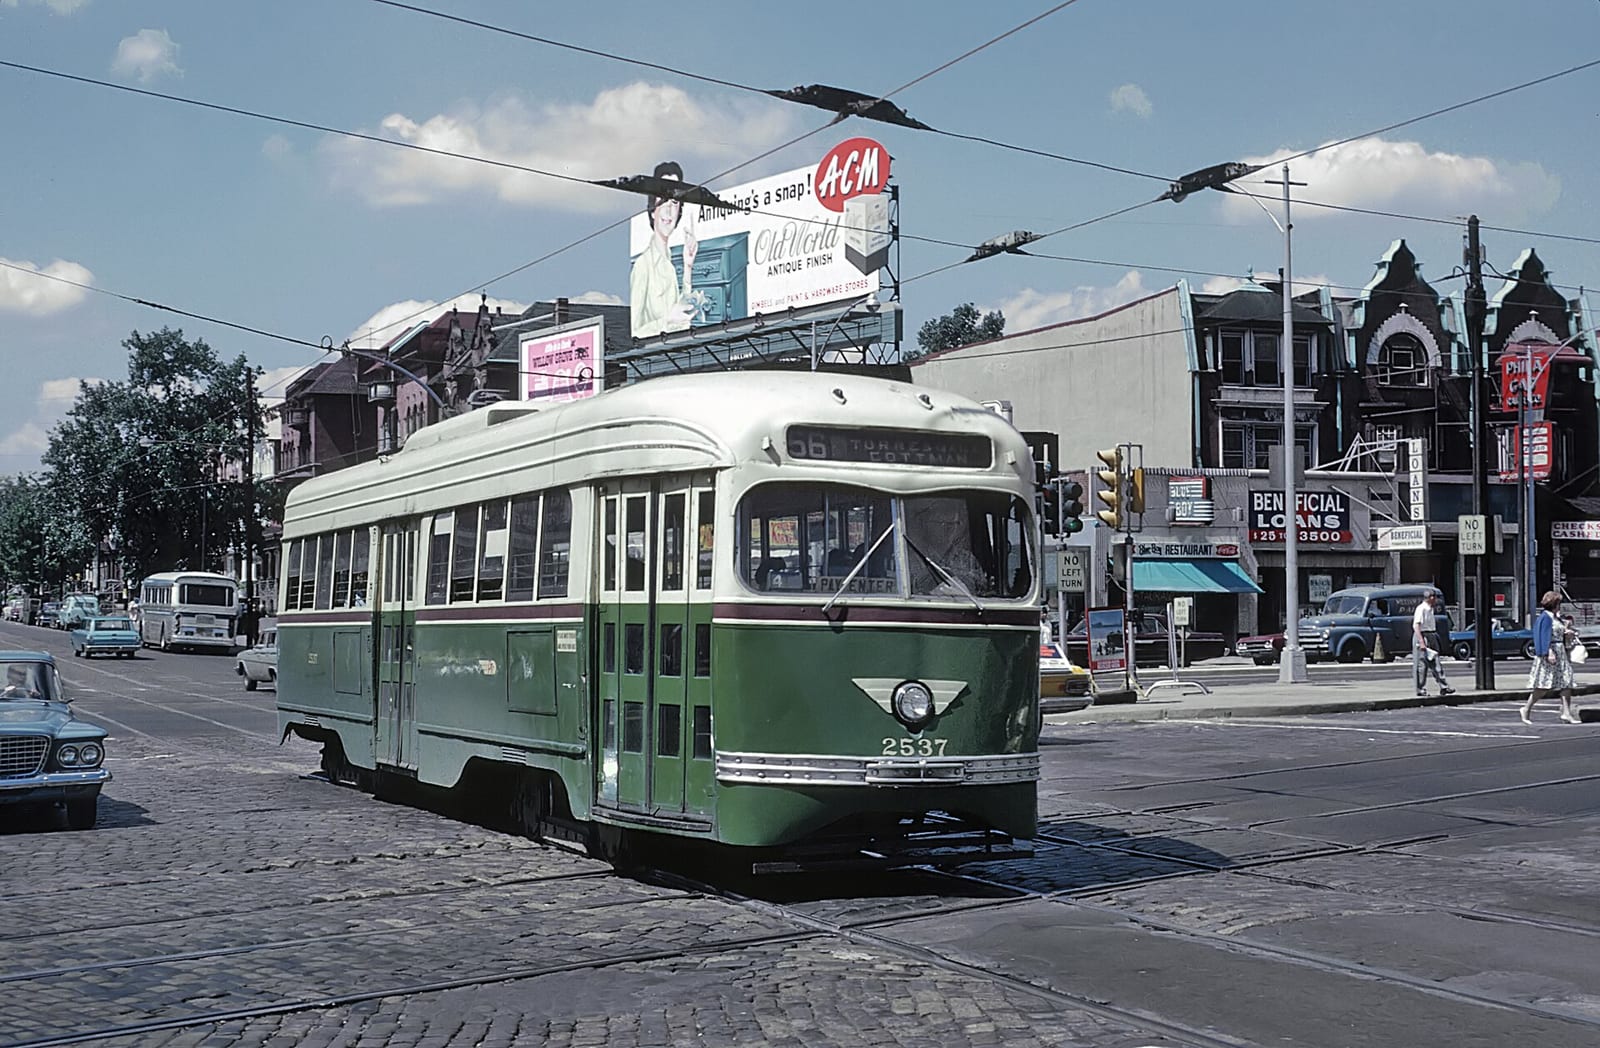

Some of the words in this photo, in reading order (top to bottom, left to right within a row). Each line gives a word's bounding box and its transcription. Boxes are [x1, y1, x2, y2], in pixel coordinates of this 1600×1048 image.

[763, 191, 771, 205] a
[754, 228, 787, 265] Old
[783, 215, 840, 257] World
[767, 259, 802, 277] ANTIQUE
[806, 253, 833, 269] FINISH
[845, 279, 869, 292] STORES
[1411, 442, 1421, 519] LOANS
[1175, 502, 1193, 517] BOY
[1253, 493, 1345, 513] BENFICIAL
[1257, 514, 1341, 529] LOANS
[1465, 519, 1479, 530] NO
[1390, 530, 1423, 540] BENEFICIAL
[1461, 532, 1483, 541] LEFT
[1165, 544, 1213, 556] RESTAURANT
[1461, 542, 1483, 551] TURN
[1064, 555, 1079, 566] NO
[1061, 568, 1081, 577] LEFT
[820, 578, 844, 592] PAY
[851, 578, 894, 593] ENTER
[1060, 579, 1082, 587] TURN
[882, 738, 948, 757] 2537
